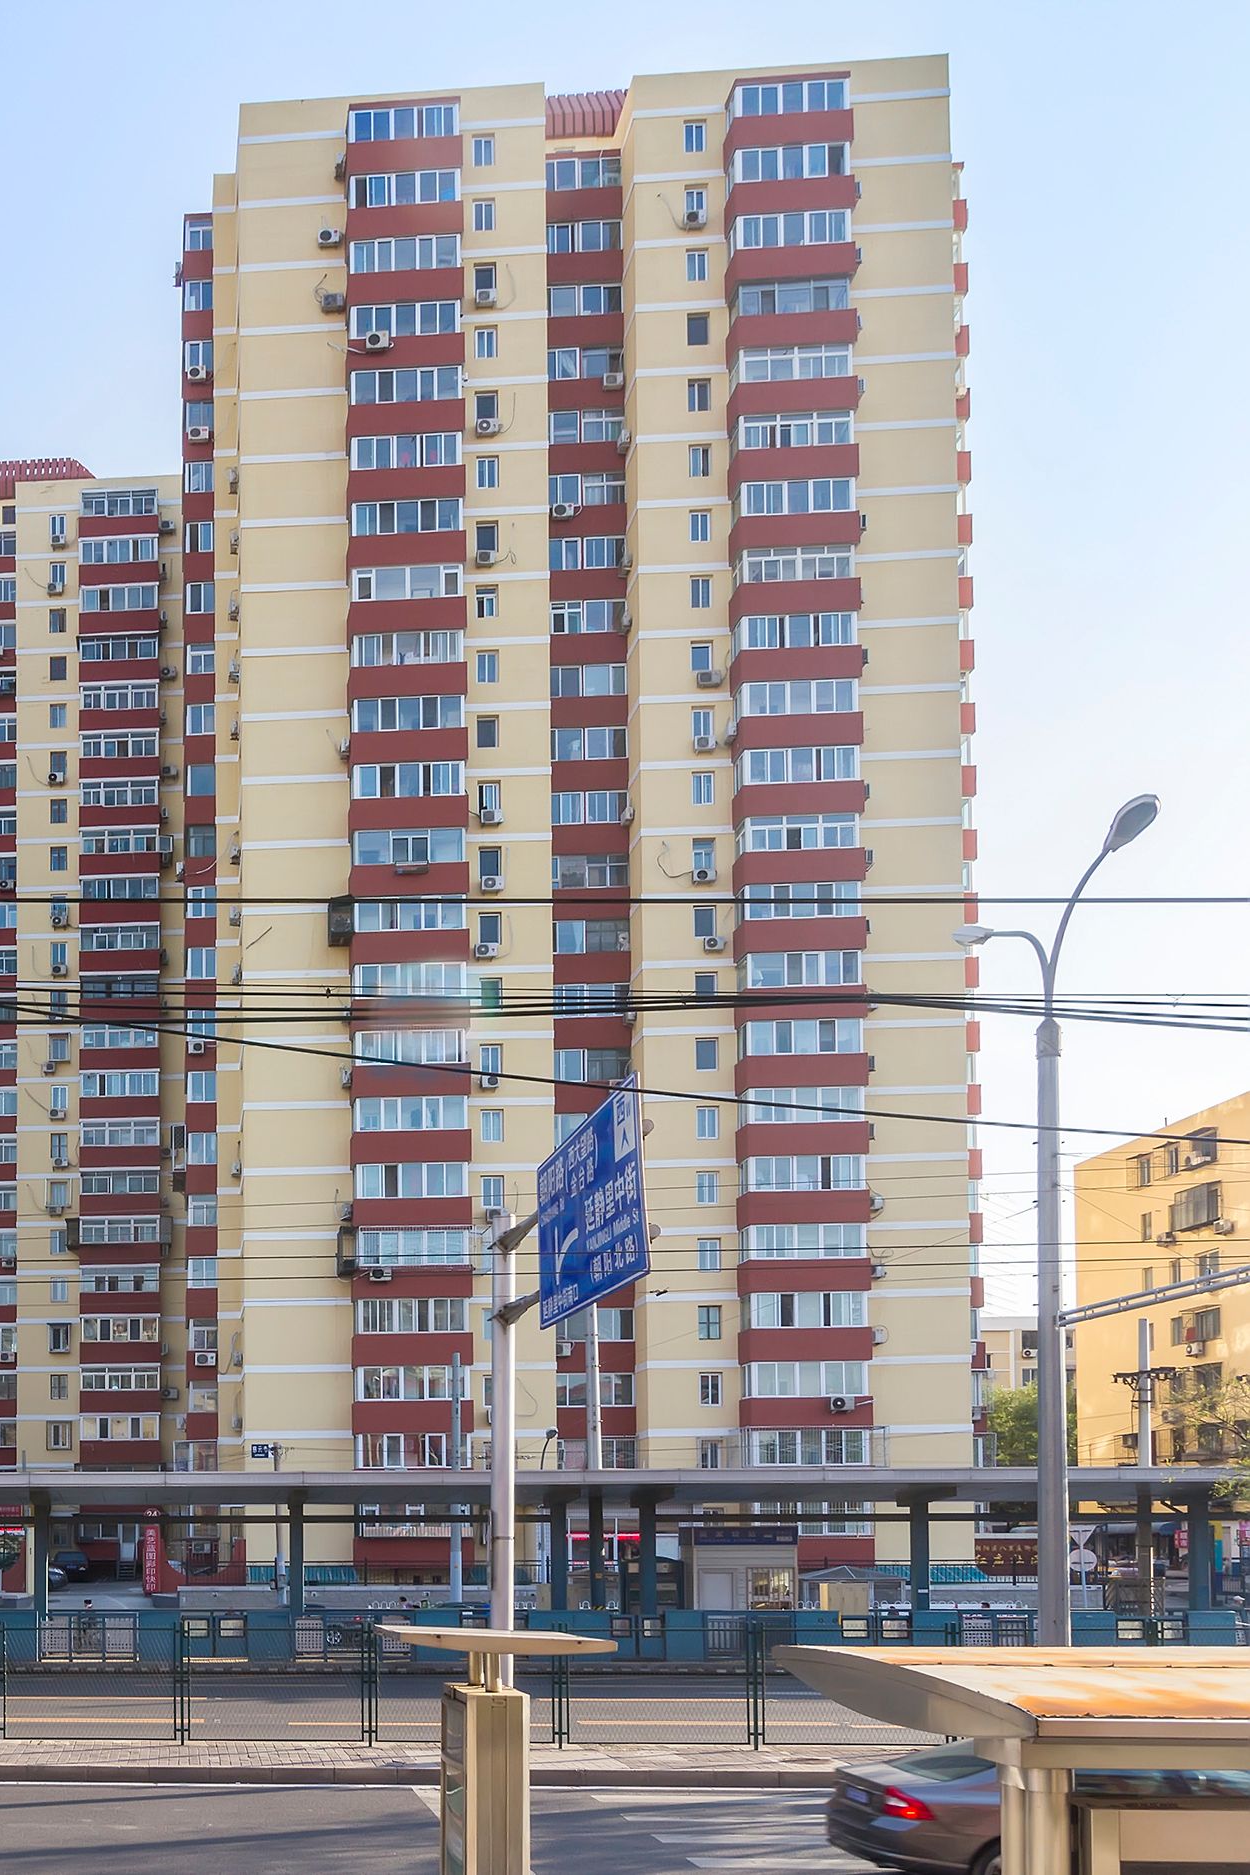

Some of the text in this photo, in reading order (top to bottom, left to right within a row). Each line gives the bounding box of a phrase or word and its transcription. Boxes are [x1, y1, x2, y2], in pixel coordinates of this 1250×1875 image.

[539, 1157, 564, 1207] 朝阳路
[585, 1161, 637, 1235] 延静里中街
